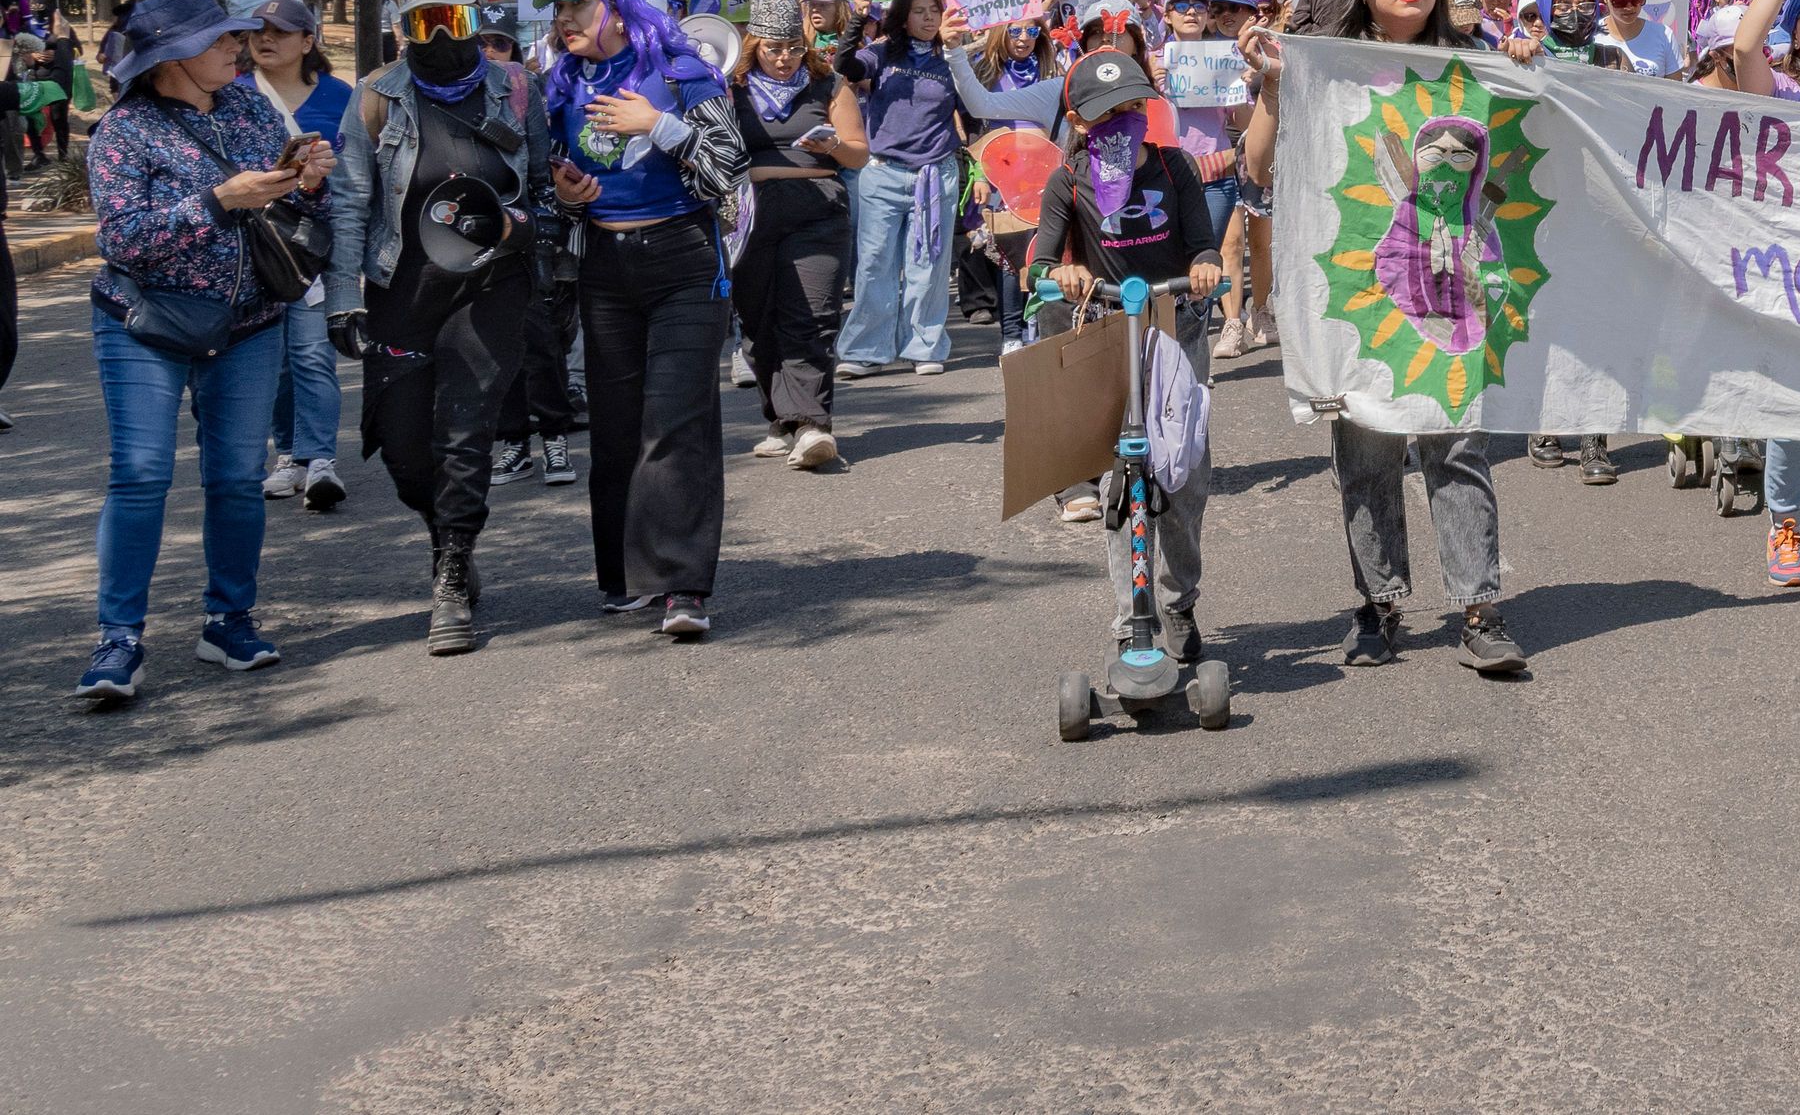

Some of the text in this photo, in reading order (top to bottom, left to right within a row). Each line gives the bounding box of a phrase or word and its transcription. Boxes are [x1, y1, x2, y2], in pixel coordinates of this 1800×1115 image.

[1169, 47, 1246, 72] Las niñas
[1194, 84, 1209, 96] se
[1213, 79, 1245, 97] tocan
[1101, 239, 1134, 248] UNDER
